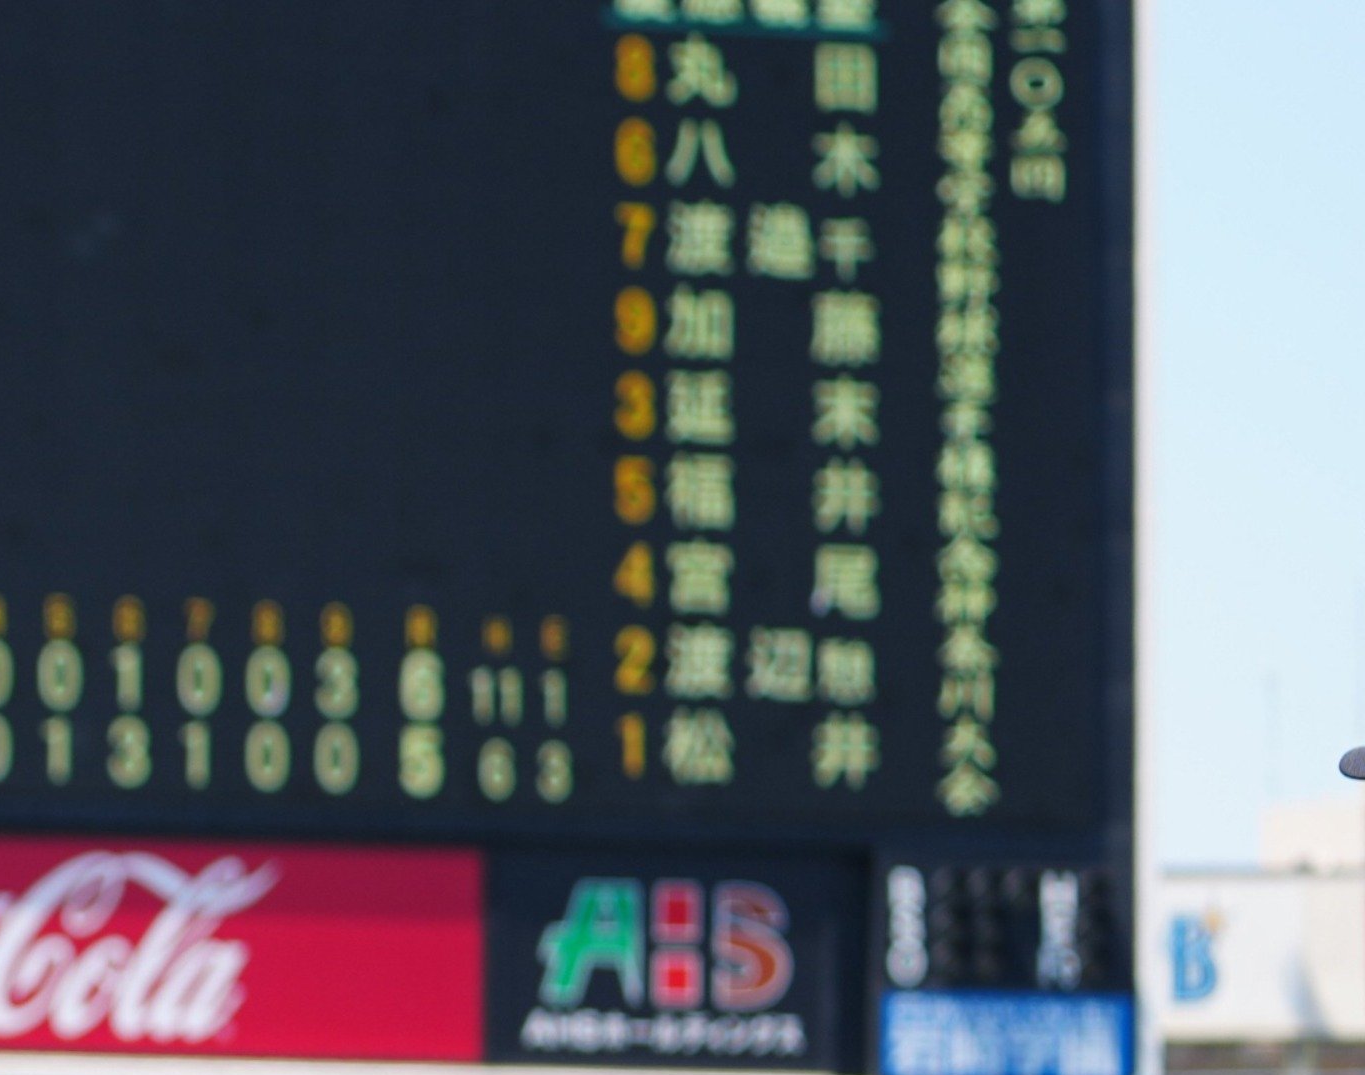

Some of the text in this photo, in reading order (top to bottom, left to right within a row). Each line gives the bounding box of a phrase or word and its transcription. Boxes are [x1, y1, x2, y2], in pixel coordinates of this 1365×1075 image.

[614, 202, 657, 268] 7
[614, 369, 657, 440] 3
[614, 455, 657, 525] 5
[614, 540, 657, 608] 4
[36, 638, 84, 713] 0
[111, 642, 144, 714] 1
[175, 643, 223, 718] 0
[244, 645, 292, 720] 0
[314, 648, 360, 720] 3
[540, 668, 567, 729] 1
[614, 625, 657, 695] 2
[39, 712, 73, 788] 1
[106, 714, 153, 790] 3
[181, 718, 211, 791] 1
[244, 720, 291, 794] 0
[313, 720, 360, 796] 0
[398, 721, 445, 800] 5
[536, 738, 574, 805] 3
[618, 712, 647, 778] 1
